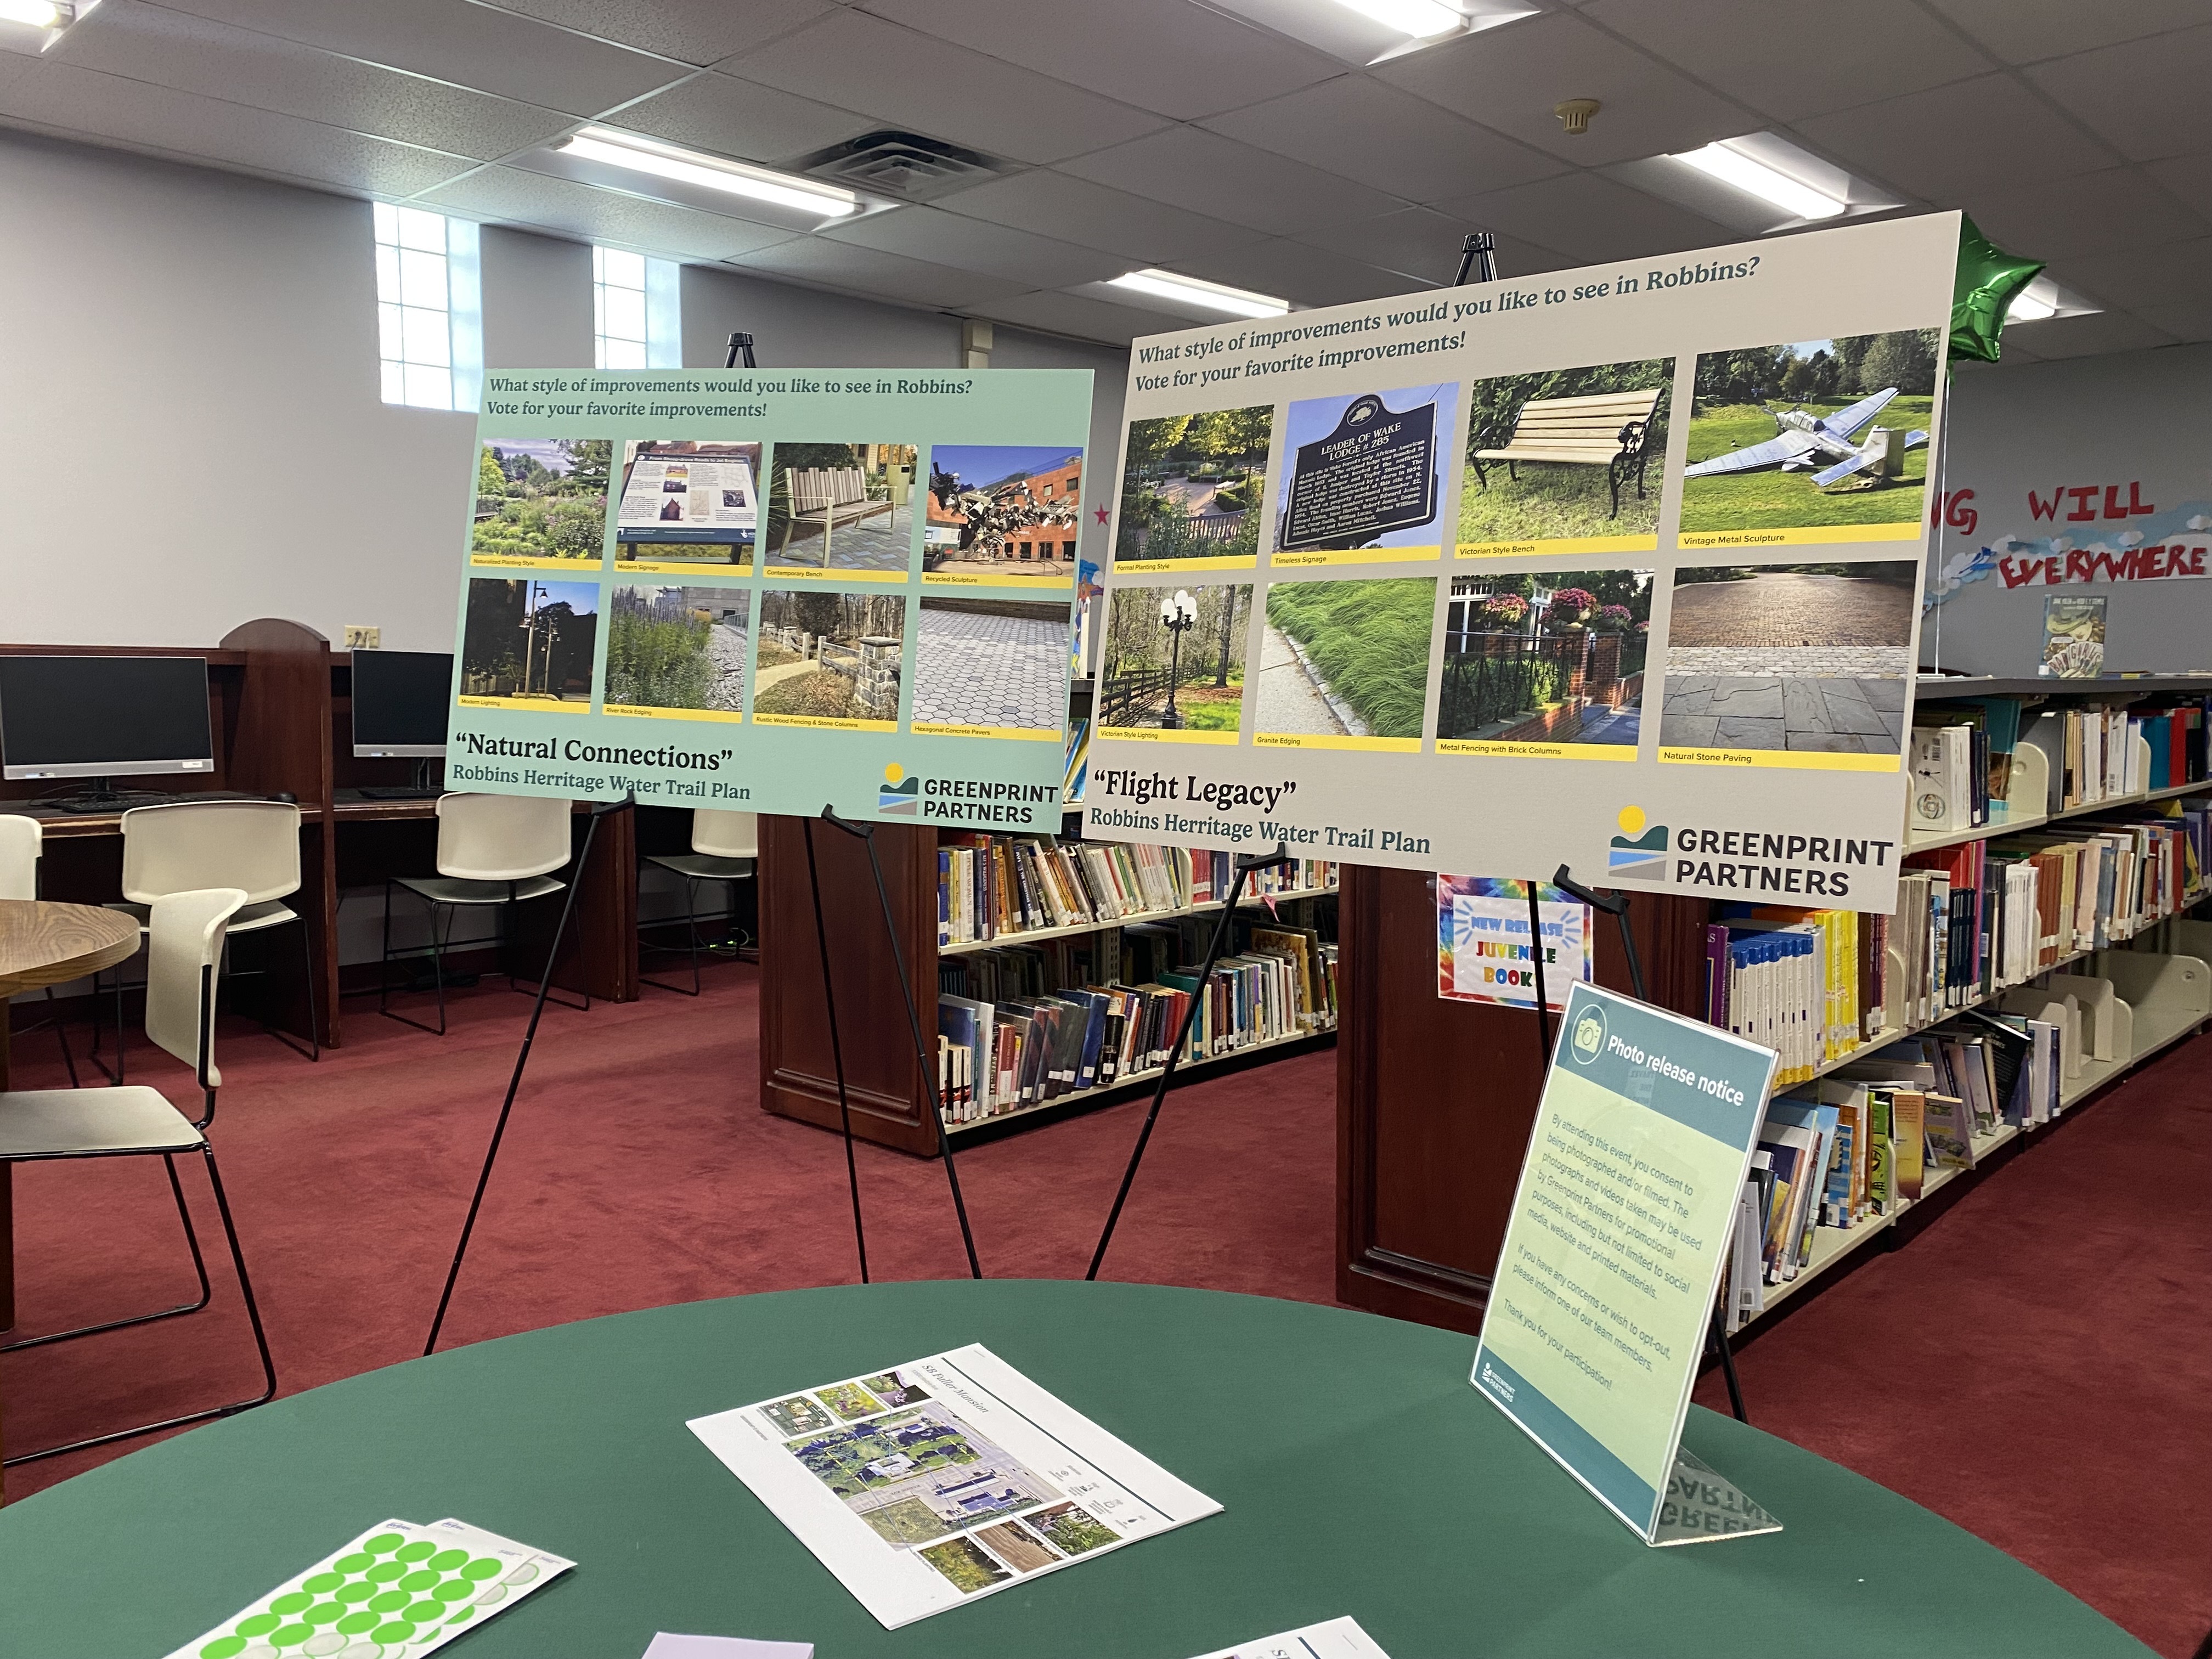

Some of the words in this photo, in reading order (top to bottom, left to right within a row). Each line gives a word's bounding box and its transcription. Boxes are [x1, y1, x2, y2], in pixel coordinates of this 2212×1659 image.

[1139, 345, 1180, 363] What
[1184, 337, 1223, 358] style
[1228, 332, 1246, 351] of
[1249, 315, 1380, 348] improvements
[1387, 302, 1448, 327] would
[1453, 301, 1492, 322] you
[1498, 291, 1538, 311] like
[1544, 288, 1566, 304] to
[1572, 282, 1609, 301] see
[1616, 275, 1638, 295] in
[1646, 256, 1760, 291] Robbins?
[1135, 373, 1169, 392] Vote
[1173, 370, 1198, 386] for
[1201, 364, 1241, 387] your
[1245, 354, 1313, 377] favorite
[1318, 336, 1466, 368] improvements!
[490, 379, 528, 391] What
[532, 379, 567, 394] style
[571, 378, 586, 392] of
[590, 380, 699, 395] improvements
[705, 379, 752, 392] would
[757, 383, 786, 396] you
[791, 379, 820, 393] like
[825, 381, 840, 393] to
[845, 382, 871, 393] see
[876, 380, 891, 393] in
[897, 380, 973, 394] Robbins?
[488, 402, 518, 415] Vote
[523, 402, 544, 415] for
[548, 405, 583, 417] your
[586, 402, 645, 415] favorite
[650, 402, 766, 419] improvements!
[1321, 438, 1355, 455] LEADER
[1358, 432, 1372, 443] OF
[1374, 422, 1401, 438] WAKE
[1329, 444, 1361, 461] LODGE
[1371, 436, 1390, 448] 285
[1375, 448, 1396, 458] African
[1398, 440, 1425, 451] American
[2028, 481, 2154, 522] WILL
[1492, 546, 1510, 555] Style
[1684, 537, 1716, 545] Vintage
[1718, 535, 1741, 544] Metal
[1743, 534, 1785, 544] Sculpture
[1135, 563, 1155, 572] Planting
[1999, 544, 2207, 589] EVERYWHERE
[456, 732, 557, 759] “Natural
[565, 740, 732, 770] Connections”
[1280, 738, 1300, 746] Edging
[1462, 745, 1489, 754] Fencing
[1664, 752, 1694, 760] Natural
[1696, 753, 1721, 761] Stone
[1723, 754, 1751, 763] Paving
[452, 764, 518, 783] Robbins
[524, 770, 604, 793] Herritage
[609, 775, 661, 794] Water
[666, 780, 706, 797] Trail
[711, 783, 751, 800] Plan
[924, 779, 1058, 803] GREENPRINT
[1094, 769, 1179, 804] “Flight
[1186, 775, 1296, 814] Legacy”
[924, 800, 1032, 823] PARTNERS
[1091, 808, 1159, 830] Robbins
[1164, 814, 1253, 842] Herritage
[1259, 821, 1319, 844] Water
[1325, 826, 1374, 850] Trail
[1381, 831, 1431, 854] Plan
[1677, 828, 1893, 866] GREENPRINT
[1676, 859, 1849, 897] PARTNERS
[1471, 916, 1502, 932] NEW
[1505, 919, 1563, 936] RELASE
[1607, 1035, 1645, 1064] Photo
[1646, 1056, 1695, 1086] release
[1697, 1075, 1743, 1107] notice
[1552, 1114, 1561, 1124] By
[1561, 1120, 1594, 1146] attending
[1594, 1136, 1609, 1152] this
[1610, 1146, 1632, 1166] event,
[1633, 1157, 1648, 1173] you
[1650, 1167, 1683, 1191] consent
[1684, 1183, 1694, 1197] to
[1547, 1132, 1566, 1153] being
[1566, 1144, 1616, 1178] photographed
[1617, 1172, 1643, 1193] and/or
[1644, 1186, 1670, 1209] filmed.
[1673, 1200, 1689, 1218] The
[1542, 1152, 1584, 1183] photographs
[1585, 1176, 1599, 1192] and
[1600, 1184, 1625, 1206] videos
[1626, 1200, 1647, 1220] taken
[1648, 1213, 1667, 1232] may
[1668, 1222, 1679, 1237] be
[1680, 1231, 1703, 1250] used
[922, 1364, 937, 1373] SB
[932, 1373, 957, 1391] Fuller
[953, 1389, 989, 1413] Mansion
